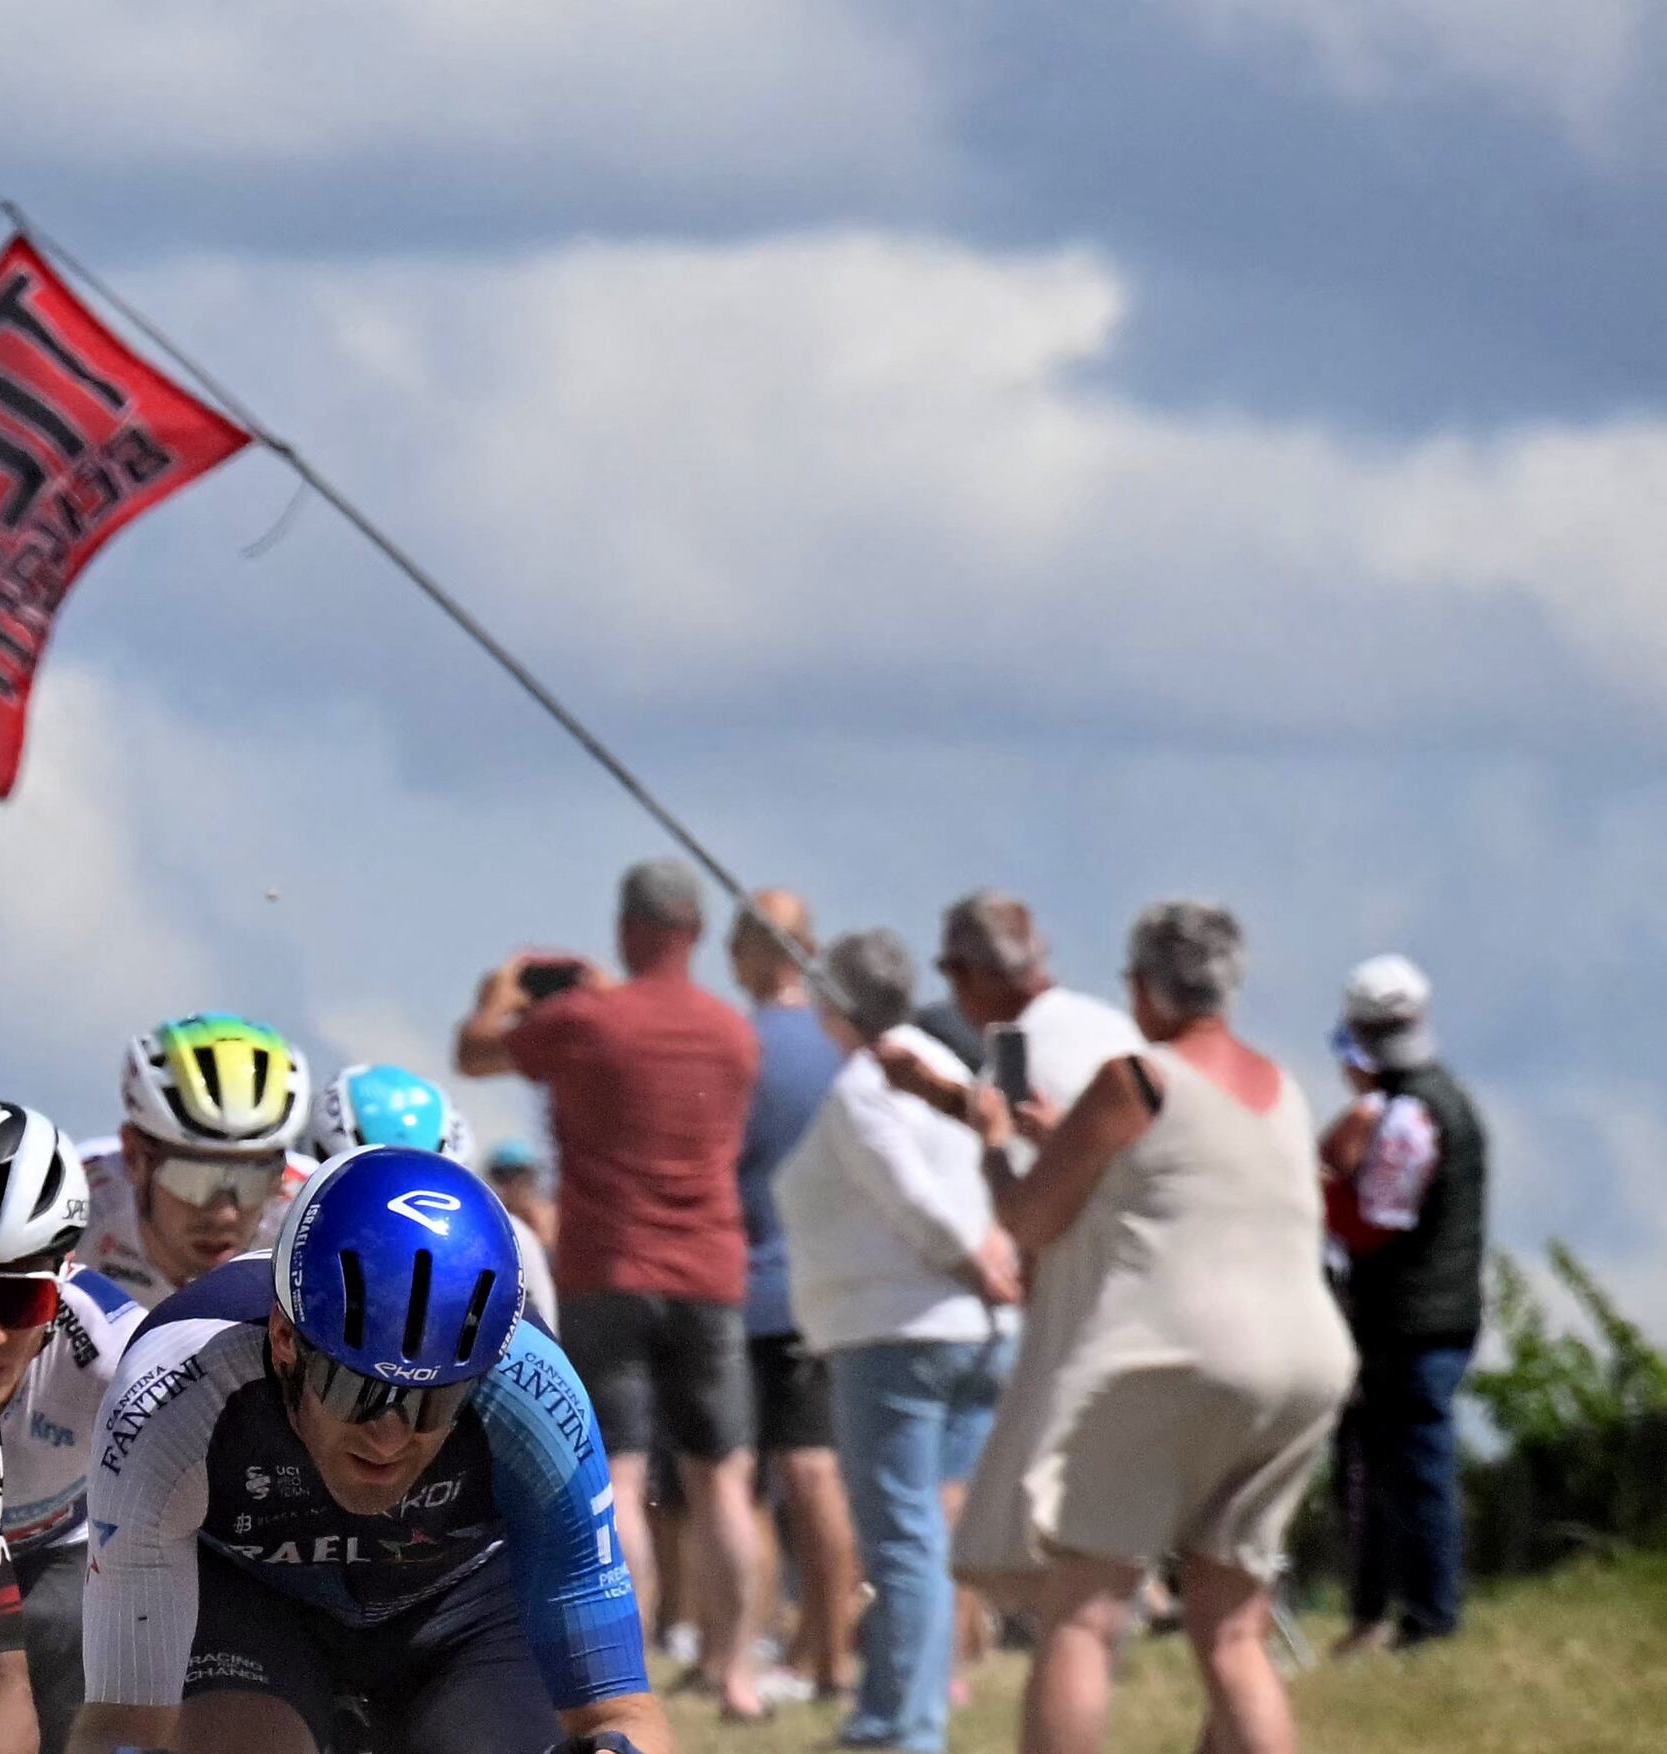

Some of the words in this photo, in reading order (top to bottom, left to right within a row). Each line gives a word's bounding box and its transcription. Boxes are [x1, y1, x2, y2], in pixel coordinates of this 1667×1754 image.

[100, 1354, 209, 1477] FANTINI
[105, 1364, 167, 1431] CANTINA
[498, 1353, 595, 1465] ANTINI
[524, 1352, 587, 1422] CANTINA
[189, 1652, 264, 1672] RACING
